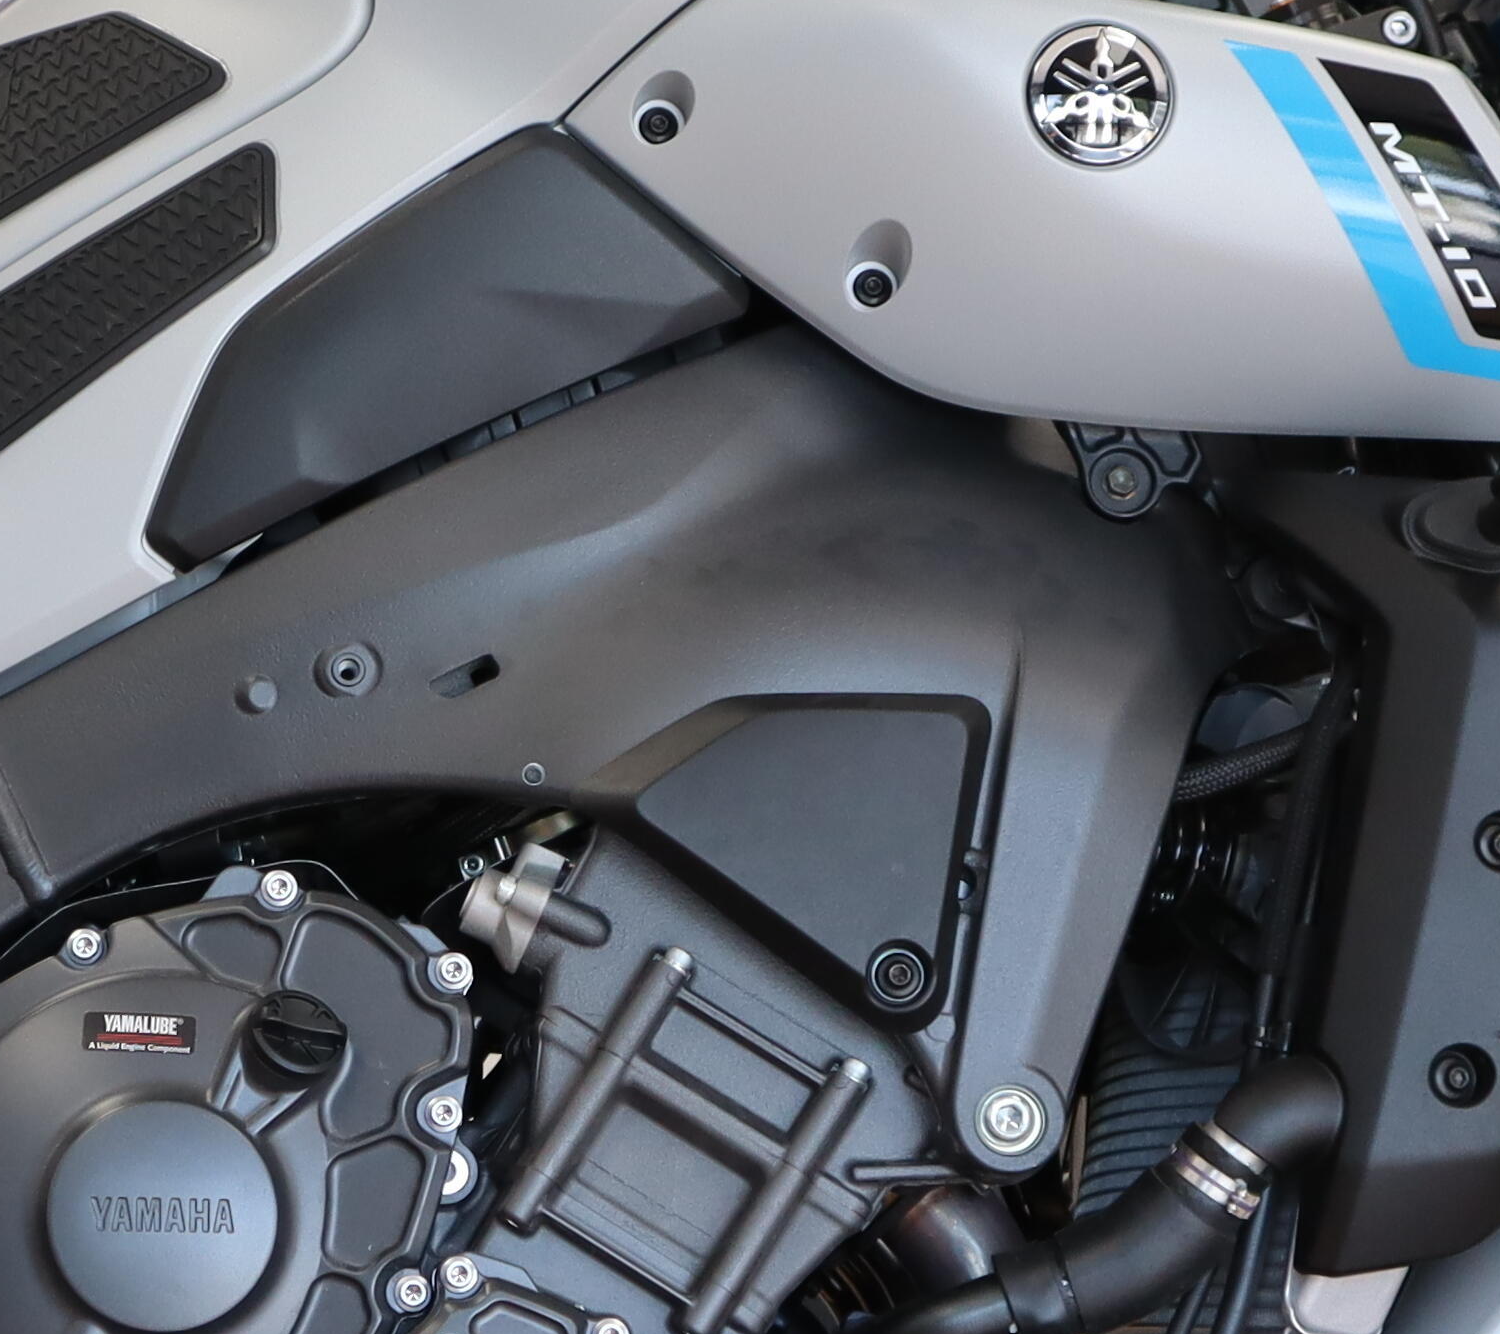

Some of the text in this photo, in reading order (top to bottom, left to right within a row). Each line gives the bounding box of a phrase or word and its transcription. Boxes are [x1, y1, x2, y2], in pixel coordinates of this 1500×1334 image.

[1369, 122, 1497, 308] MT-10
[104, 1014, 178, 1036] YAMALUBE
[90, 1196, 235, 1234] YAMAHA
